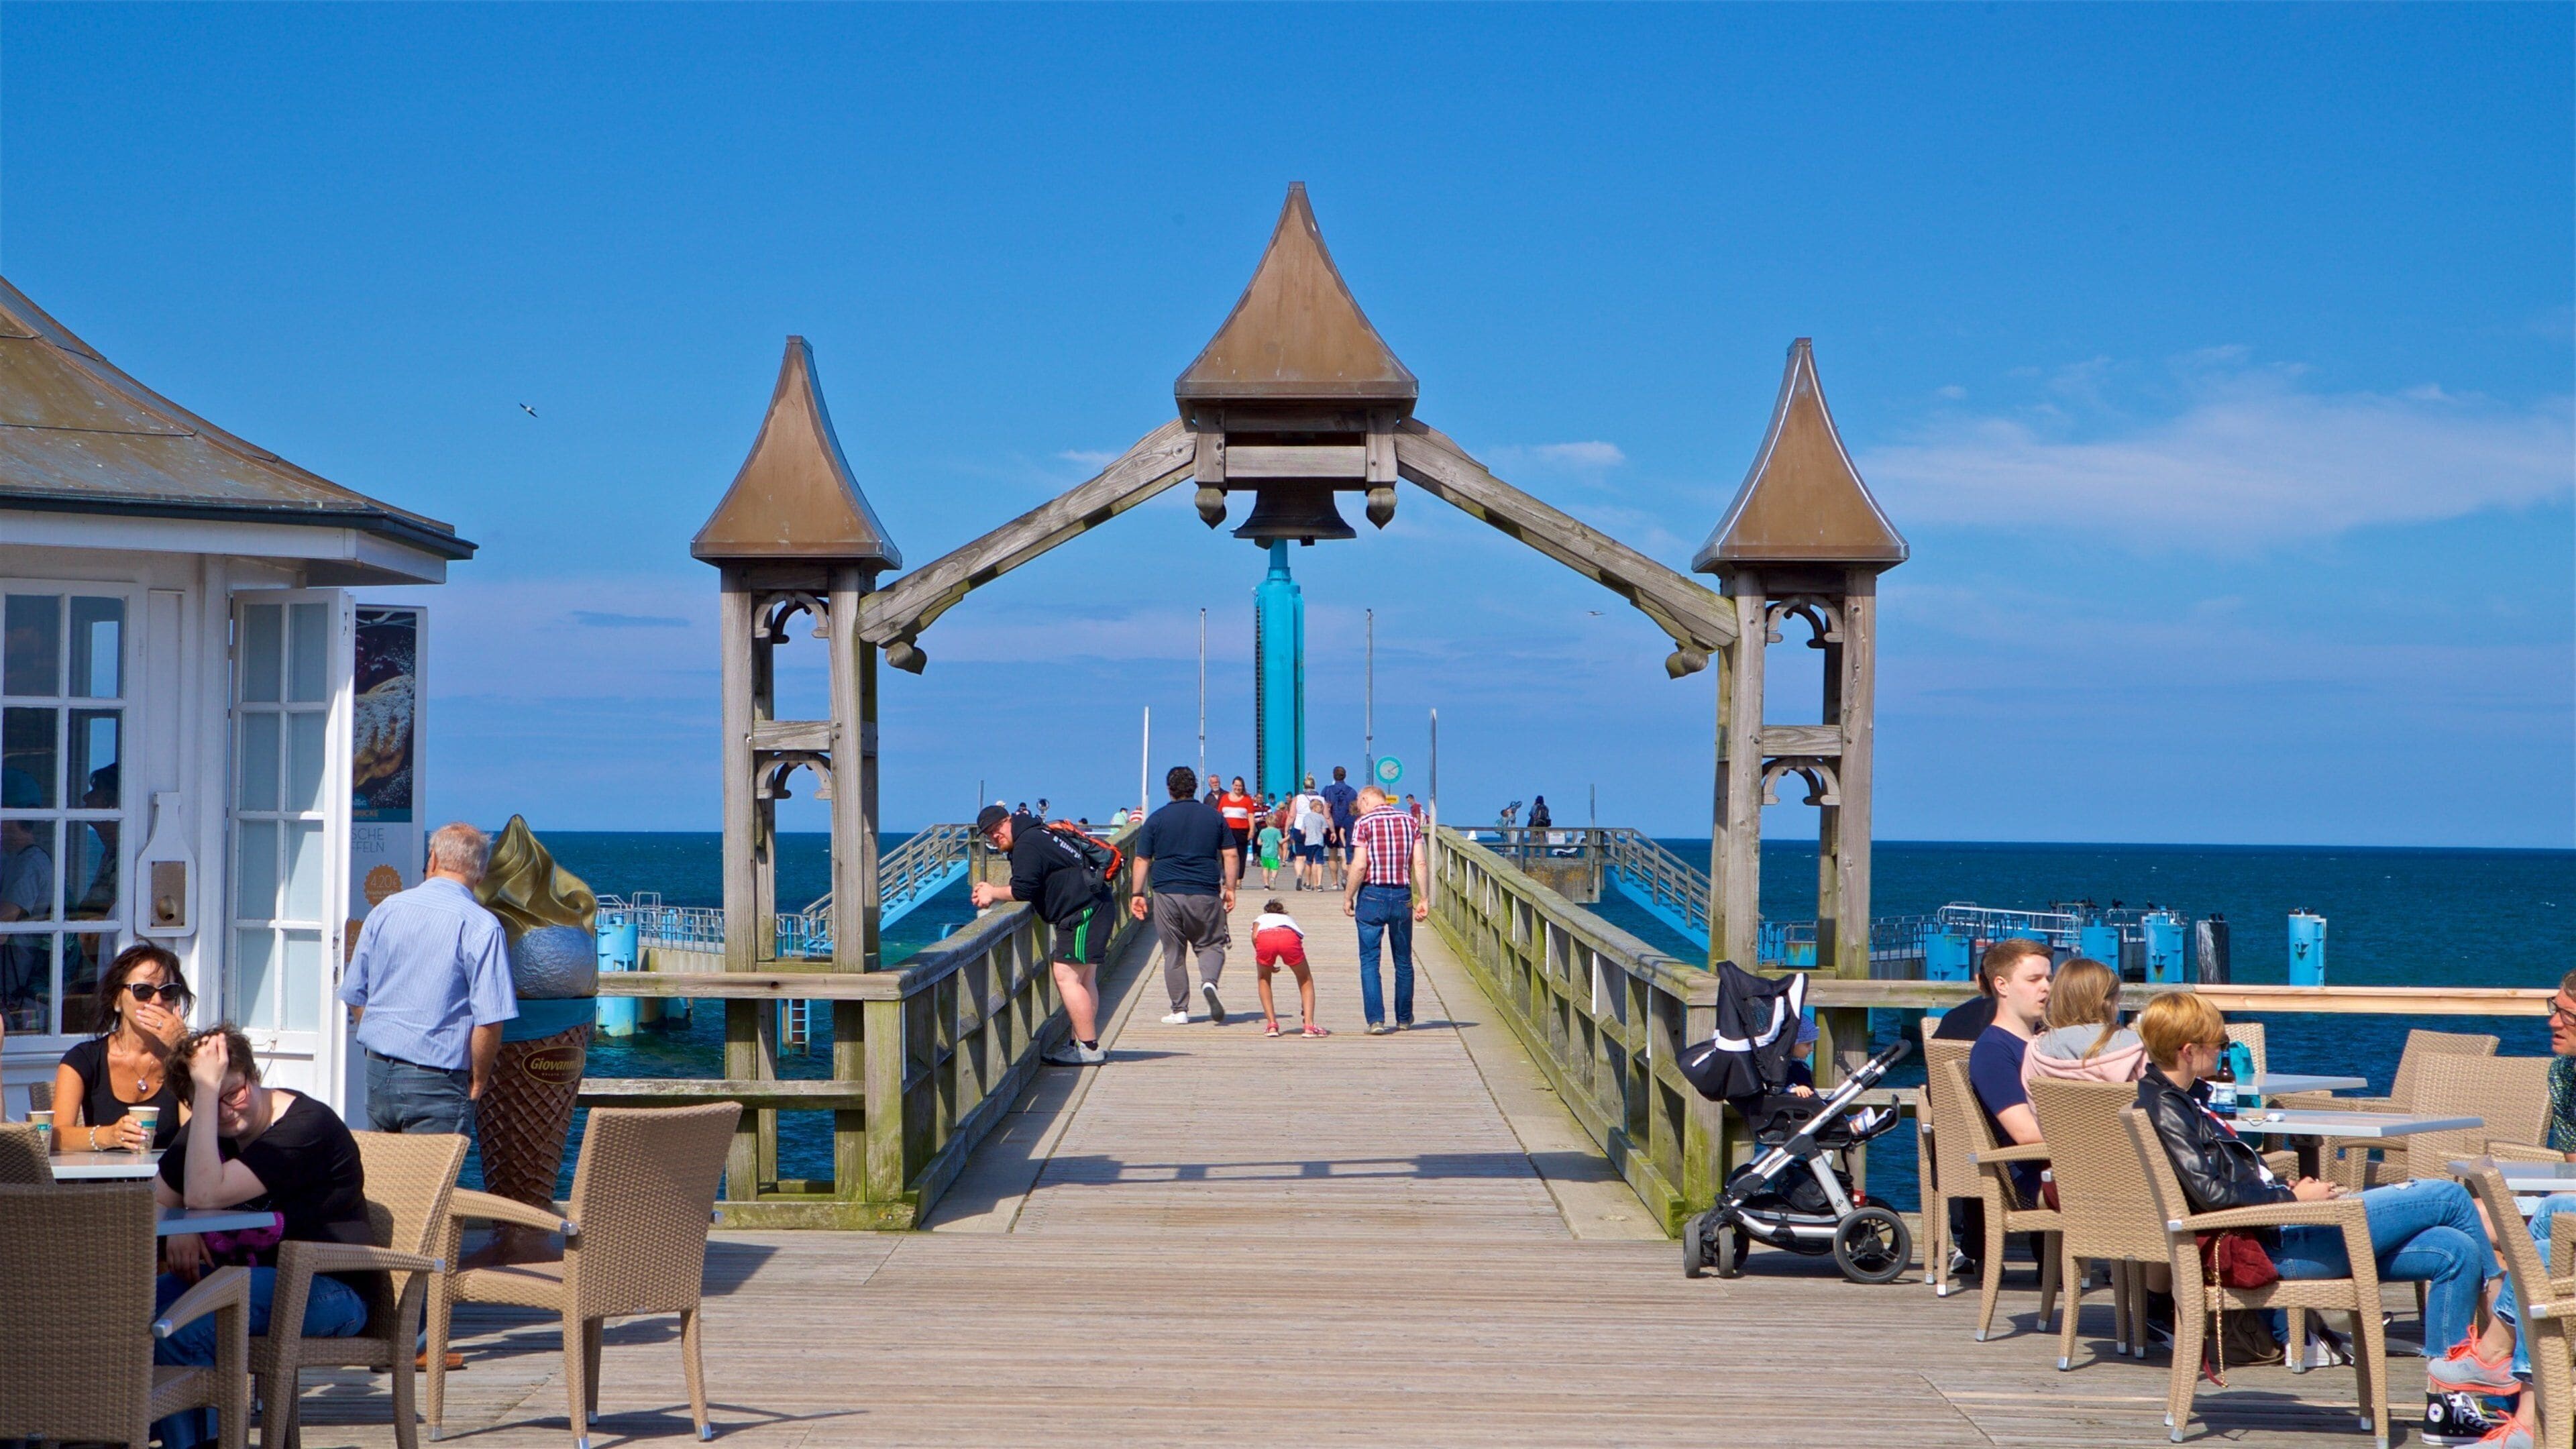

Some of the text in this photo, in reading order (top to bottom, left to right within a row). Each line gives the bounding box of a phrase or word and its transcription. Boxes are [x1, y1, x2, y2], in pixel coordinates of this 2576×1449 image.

[352, 828, 384, 841] SCHE
[352, 841, 384, 853] FFELN
[530, 1057, 578, 1071] Giovanni
